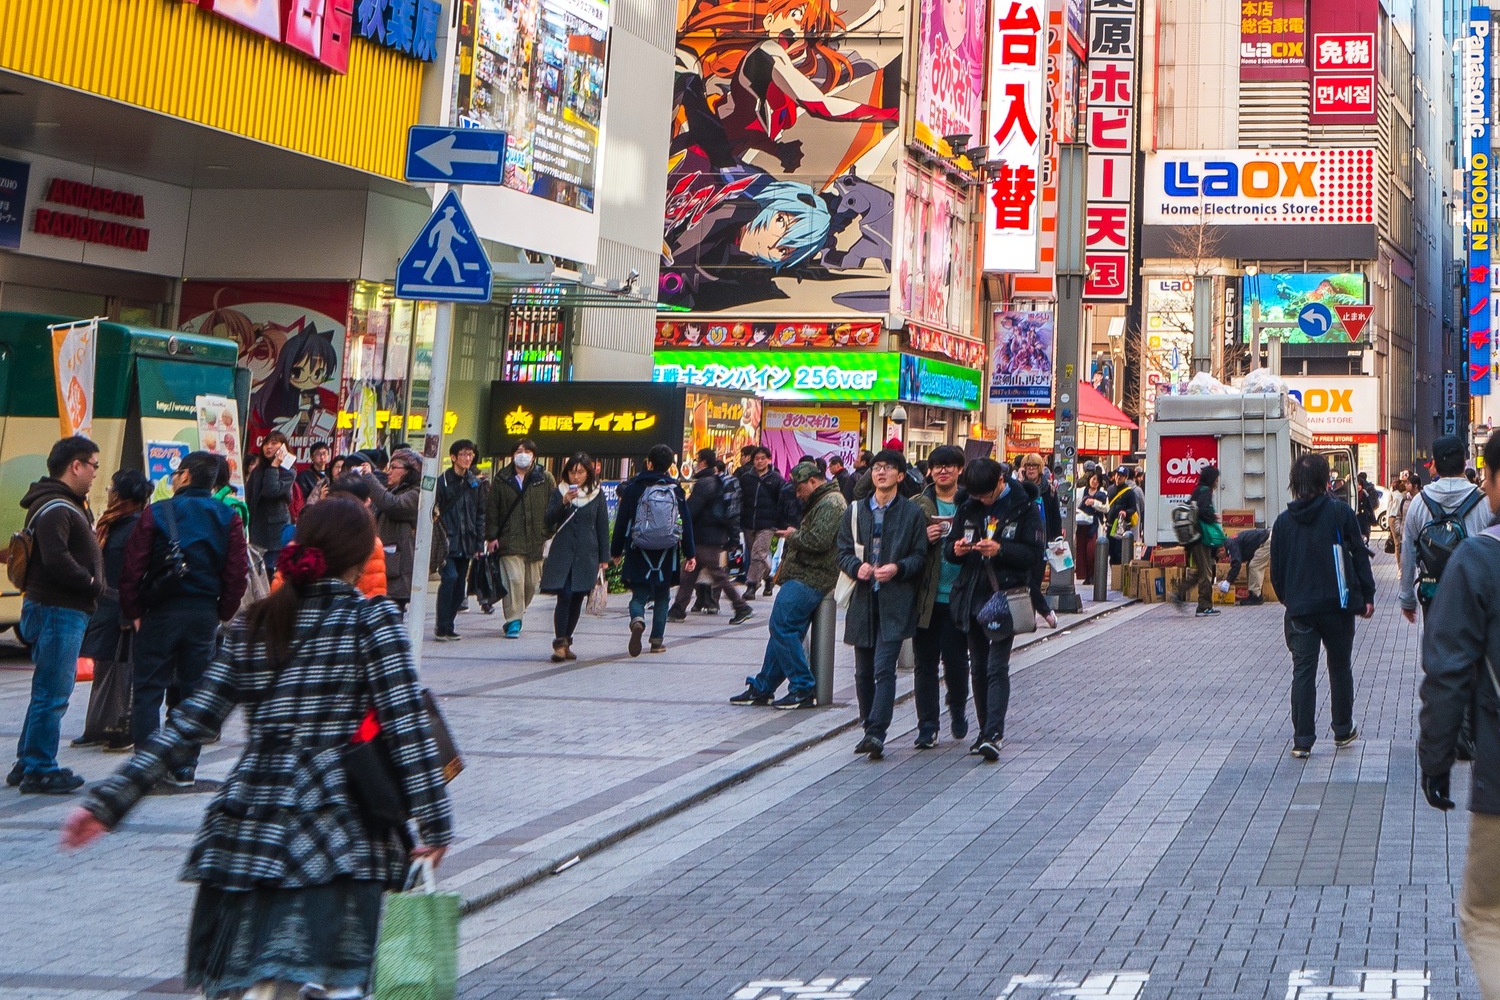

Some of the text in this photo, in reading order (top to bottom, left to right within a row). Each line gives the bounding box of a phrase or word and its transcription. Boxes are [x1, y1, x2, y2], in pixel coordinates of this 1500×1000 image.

[1241, 1, 1273, 17] 本店
[1241, 18, 1305, 34] 総合家電
[1318, 41, 1371, 65] 免税
[1468, 20, 1486, 139] Panasonic
[1317, 85, 1371, 106] 면세점
[46, 177, 145, 220] AKIHABARA
[1161, 203, 1319, 215] Home Electronics Store
[1471, 152, 1489, 251] ONODEN
[1341, 311, 1367, 323] 止まれ
[795, 368, 878, 389] 256ver
[538, 410, 656, 432] 銀座ライオン
